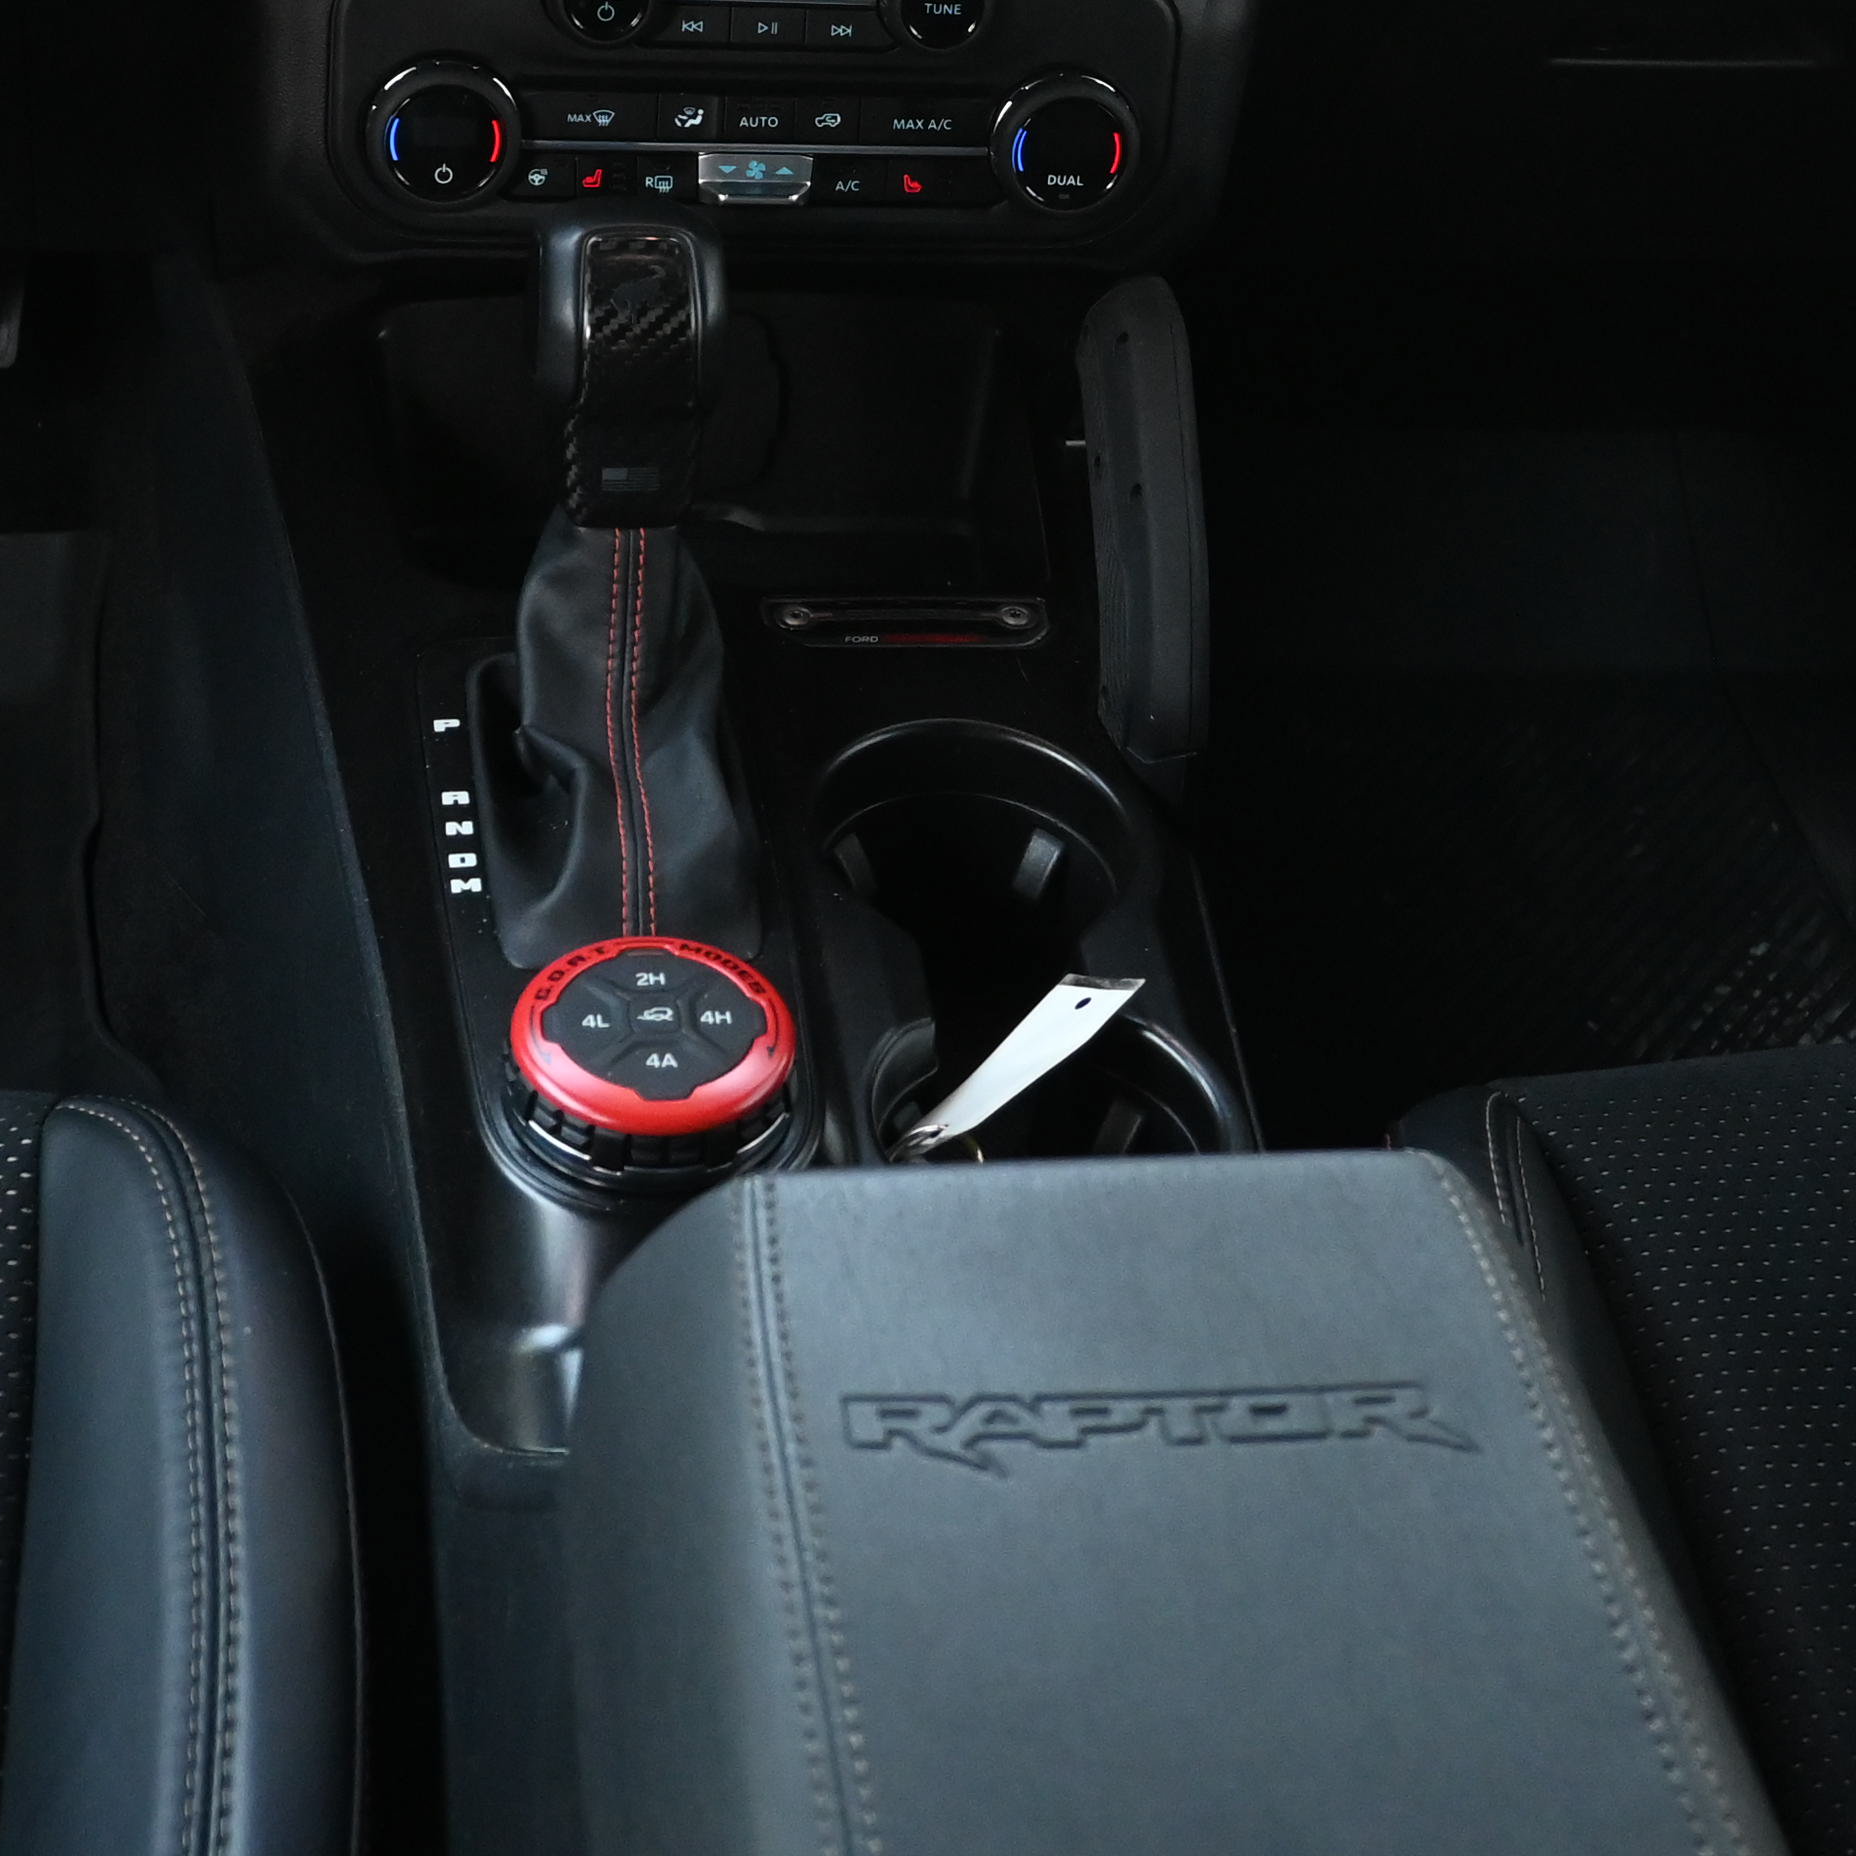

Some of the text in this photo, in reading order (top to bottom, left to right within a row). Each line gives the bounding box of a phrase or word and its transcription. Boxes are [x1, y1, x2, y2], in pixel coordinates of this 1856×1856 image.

[924, 3, 962, 15] TUNE
[567, 114, 592, 123] MAX
[739, 116, 779, 128] AUTO
[893, 118, 953, 131] MAX A/C
[645, 176, 653, 188] R
[835, 180, 860, 192] A/C
[1047, 174, 1084, 187] DUAL
[844, 635, 879, 644] FORD
[433, 718, 461, 732] P
[445, 820, 474, 836] N
[450, 877, 482, 894] M
[679, 943, 767, 995] MODES
[636, 972, 666, 987] 2H
[581, 1010, 732, 1029] 4L 4H
[646, 1053, 679, 1069] 4A
[841, 1380, 1482, 1478] RAPTOR
